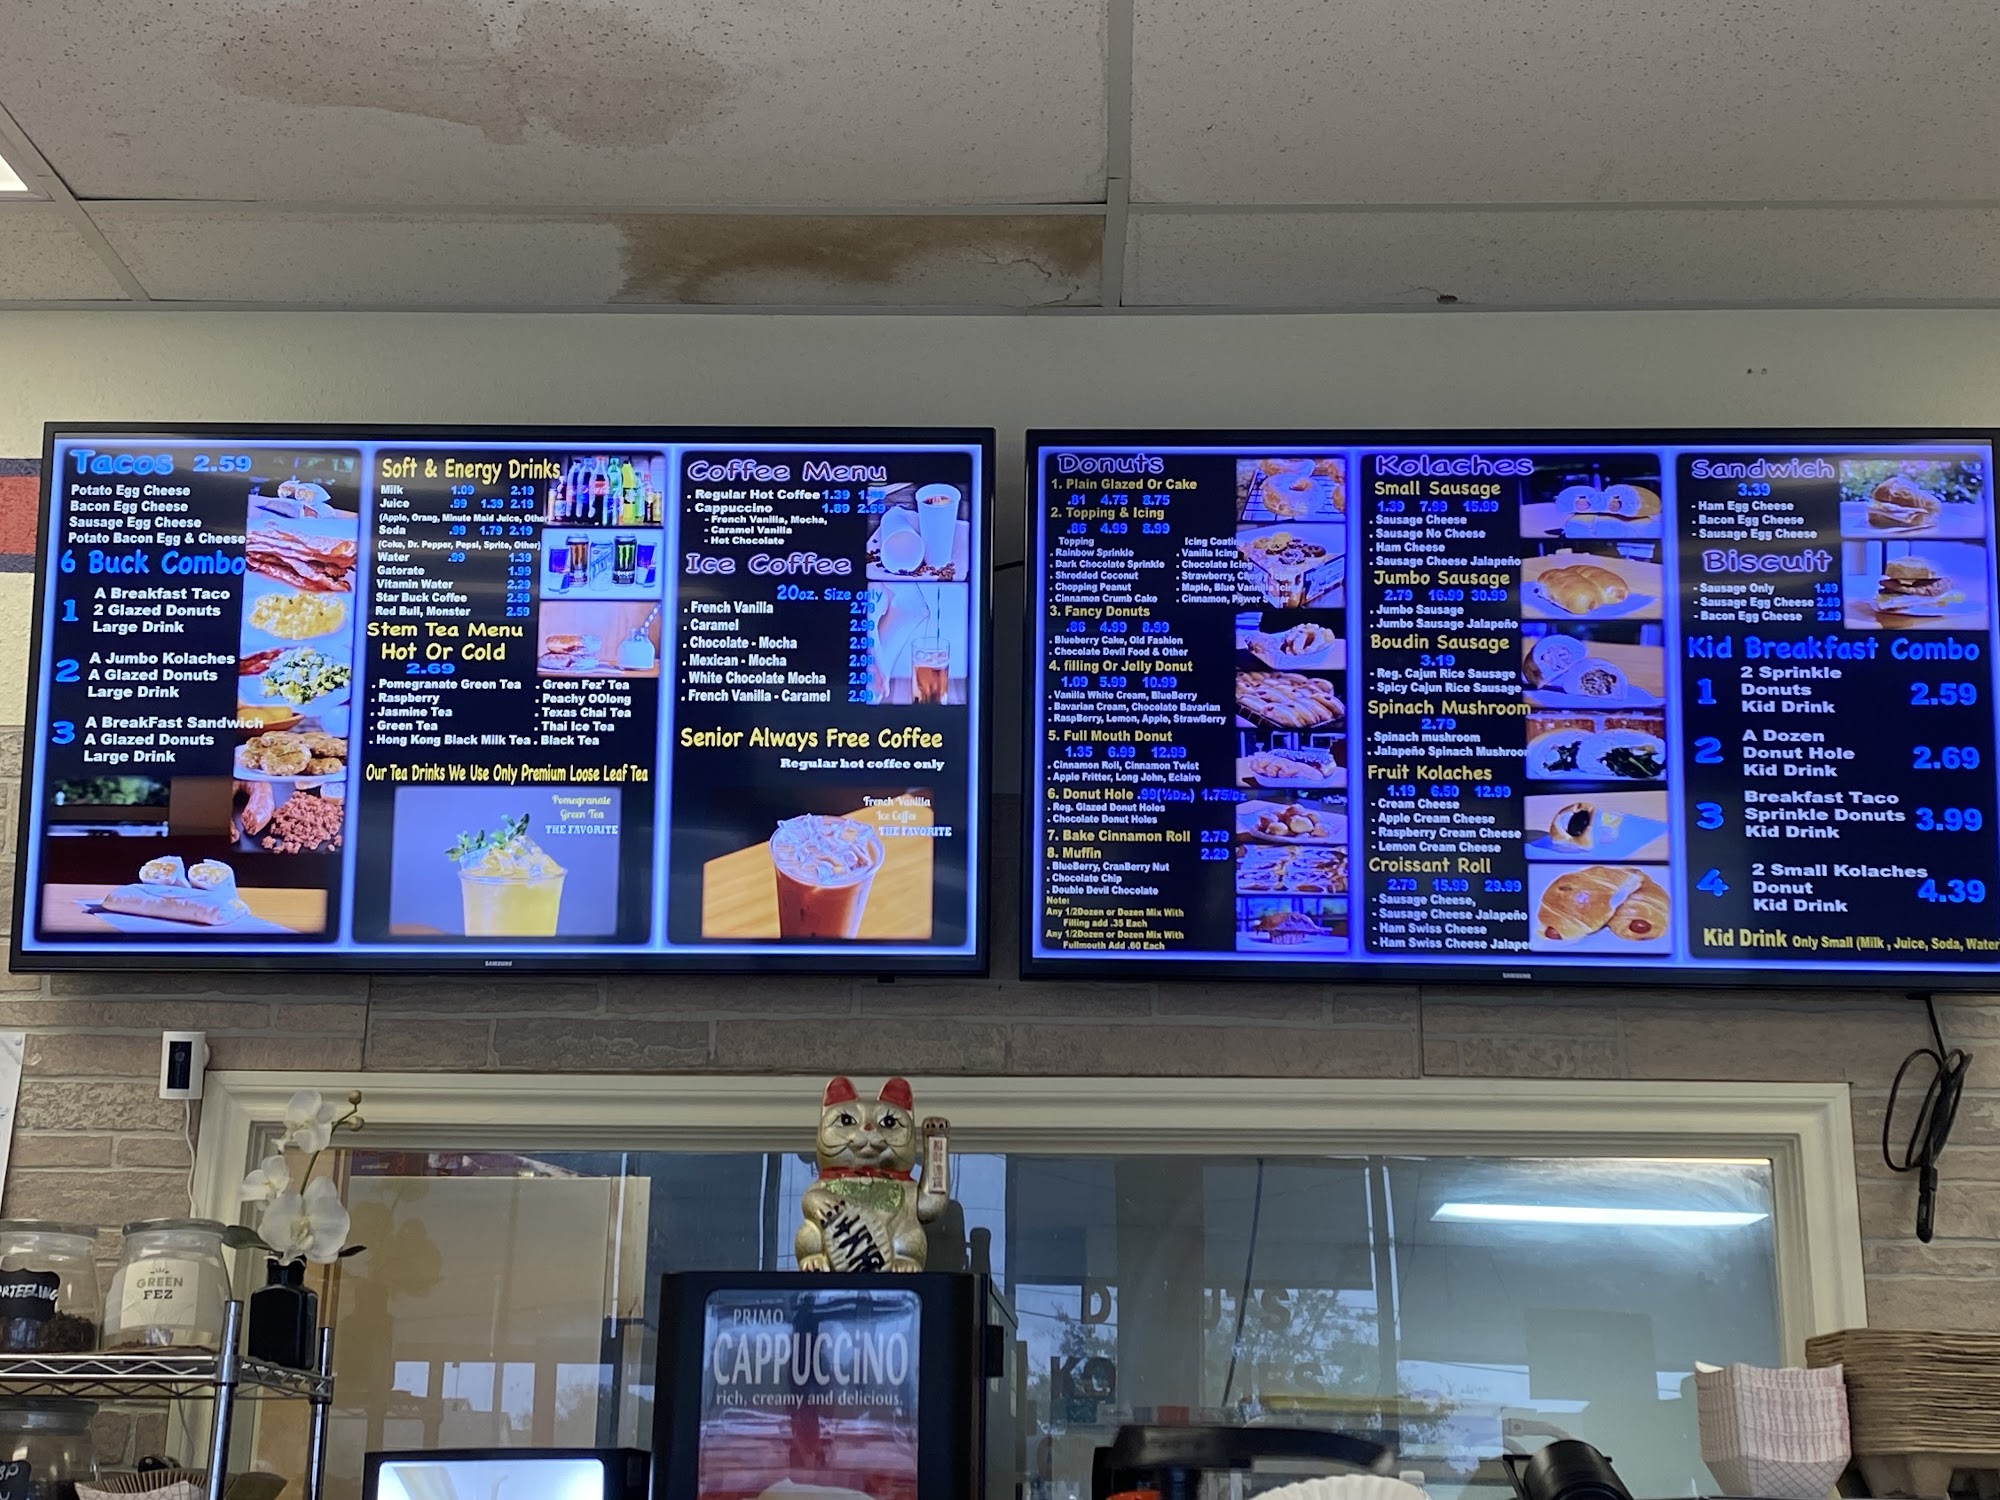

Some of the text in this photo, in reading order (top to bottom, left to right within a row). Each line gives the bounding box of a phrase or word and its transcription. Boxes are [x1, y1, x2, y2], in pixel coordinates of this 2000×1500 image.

[70, 449, 252, 475] Tacos 2.59
[1058, 454, 1164, 474] Donuts
[1376, 455, 1534, 476] Kolaches
[1692, 458, 1834, 480] Sandwich
[382, 456, 560, 485] Soft & Energy Drinks
[688, 460, 887, 482] Coffee Menu
[70, 484, 190, 498] Potato Egg Cheese
[695, 490, 820, 501] Regular Hot Coffee
[1374, 482, 1501, 498] Small Sausage
[1738, 483, 1770, 496] 3.39
[70, 501, 188, 514] Bacon Egg Cheese
[694, 503, 772, 514] Cappuccino
[69, 517, 202, 529] Sausage Egg Cheese
[68, 533, 246, 546] Potato Bacon Egg & Cheese
[60, 550, 246, 575] 6 Buck Combo
[686, 552, 852, 575] Ice Coffee
[1702, 550, 1832, 573] Biscuit
[1374, 570, 1510, 588] Jumbo Sausage
[94, 588, 230, 600] A Breakfast Taco
[62, 600, 78, 622] 1
[94, 604, 220, 616] 2 Glazed Donuts
[92, 622, 184, 634] Large Drink
[367, 622, 523, 637] Stem Tea Menu
[1370, 634, 1510, 653] Boudin Sausage
[1688, 636, 1980, 660] Kid Breakfast Combo
[89, 652, 235, 664] A Jumbo Kolaches
[381, 643, 506, 660] Hot Or Cold
[56, 659, 80, 682] 2
[88, 669, 218, 682] A Glazed Donuts
[406, 663, 455, 674] 2.69
[1740, 666, 1842, 680] 2 Sprinkle
[88, 686, 179, 700] Large Drink
[1696, 678, 1717, 704] 1
[1742, 684, 1812, 696] Donuts
[1910, 683, 1978, 705] 2.59
[378, 693, 440, 704] Raspberry
[1368, 700, 1530, 718] Spinach Mushroom
[1742, 701, 1836, 713] Kid Drink
[86, 717, 98, 728] A
[187, 718, 264, 729] Sandwich
[52, 721, 75, 744] 3
[84, 734, 214, 746] A Glazed Donuts
[680, 728, 943, 752] Senior Always Free Coffee
[1742, 730, 1824, 742] A Dozen
[84, 751, 176, 764] Large Drink
[1694, 738, 1724, 764] 2
[1743, 747, 1855, 760] Donut Hole
[1913, 746, 1980, 769] 2.69
[780, 758, 945, 772] Regular hot coffee only
[1368, 765, 1492, 780] Fruit Kolaches
[1744, 764, 1838, 776] Kid Drink
[366, 764, 648, 785] Our Tea Drinks We Use Only Premium Loose Leaf Tea
[1744, 790, 1899, 804] Breakfast Taco
[1696, 802, 1724, 830] 3
[1744, 808, 1982, 831] Sprinkle Donuts 3.99
[1047, 830, 1190, 842] 7. Bake Cinnamon Roll
[1746, 826, 1840, 838] Kid Drink
[1369, 858, 1490, 873] Croissant Roll
[1752, 864, 1928, 878] 2 Small Kolaches
[1696, 868, 1729, 896] 4
[1753, 881, 1813, 894] Donut
[1918, 879, 1986, 903] 4.39
[1754, 899, 1848, 912] Kid Drink
[1704, 928, 1788, 948] Kid Drink
[137, 1278, 183, 1288] GREEN
[144, 1290, 172, 1300] FEZ
[733, 1308, 783, 1326] PRIMO
[717, 1390, 748, 1407] rich,
[753, 1392, 803, 1409] creamy
[808, 1390, 833, 1406] and
